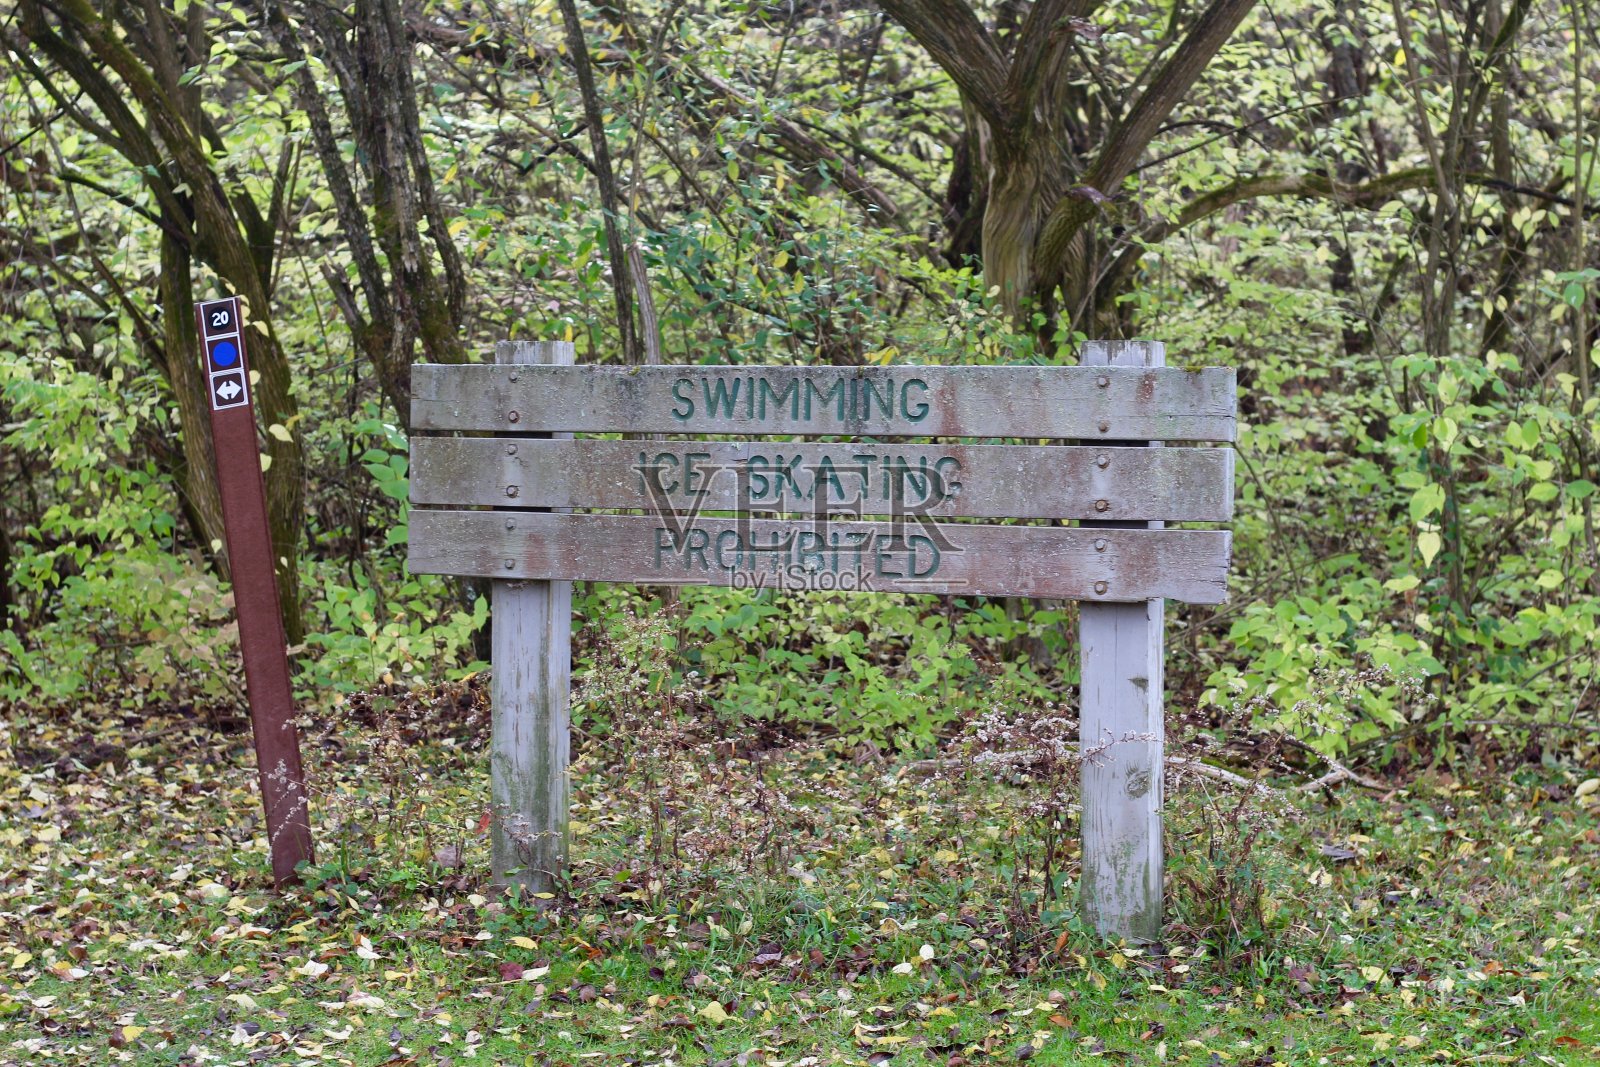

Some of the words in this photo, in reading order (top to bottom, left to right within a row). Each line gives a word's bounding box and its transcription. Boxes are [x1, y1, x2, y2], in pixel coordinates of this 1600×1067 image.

[211, 310, 229, 327] 20
[671, 377, 930, 423] SWIMMING
[637, 451, 711, 497] ICE
[746, 454, 963, 501] SKATING
[653, 526, 941, 579] PROHIBITED
